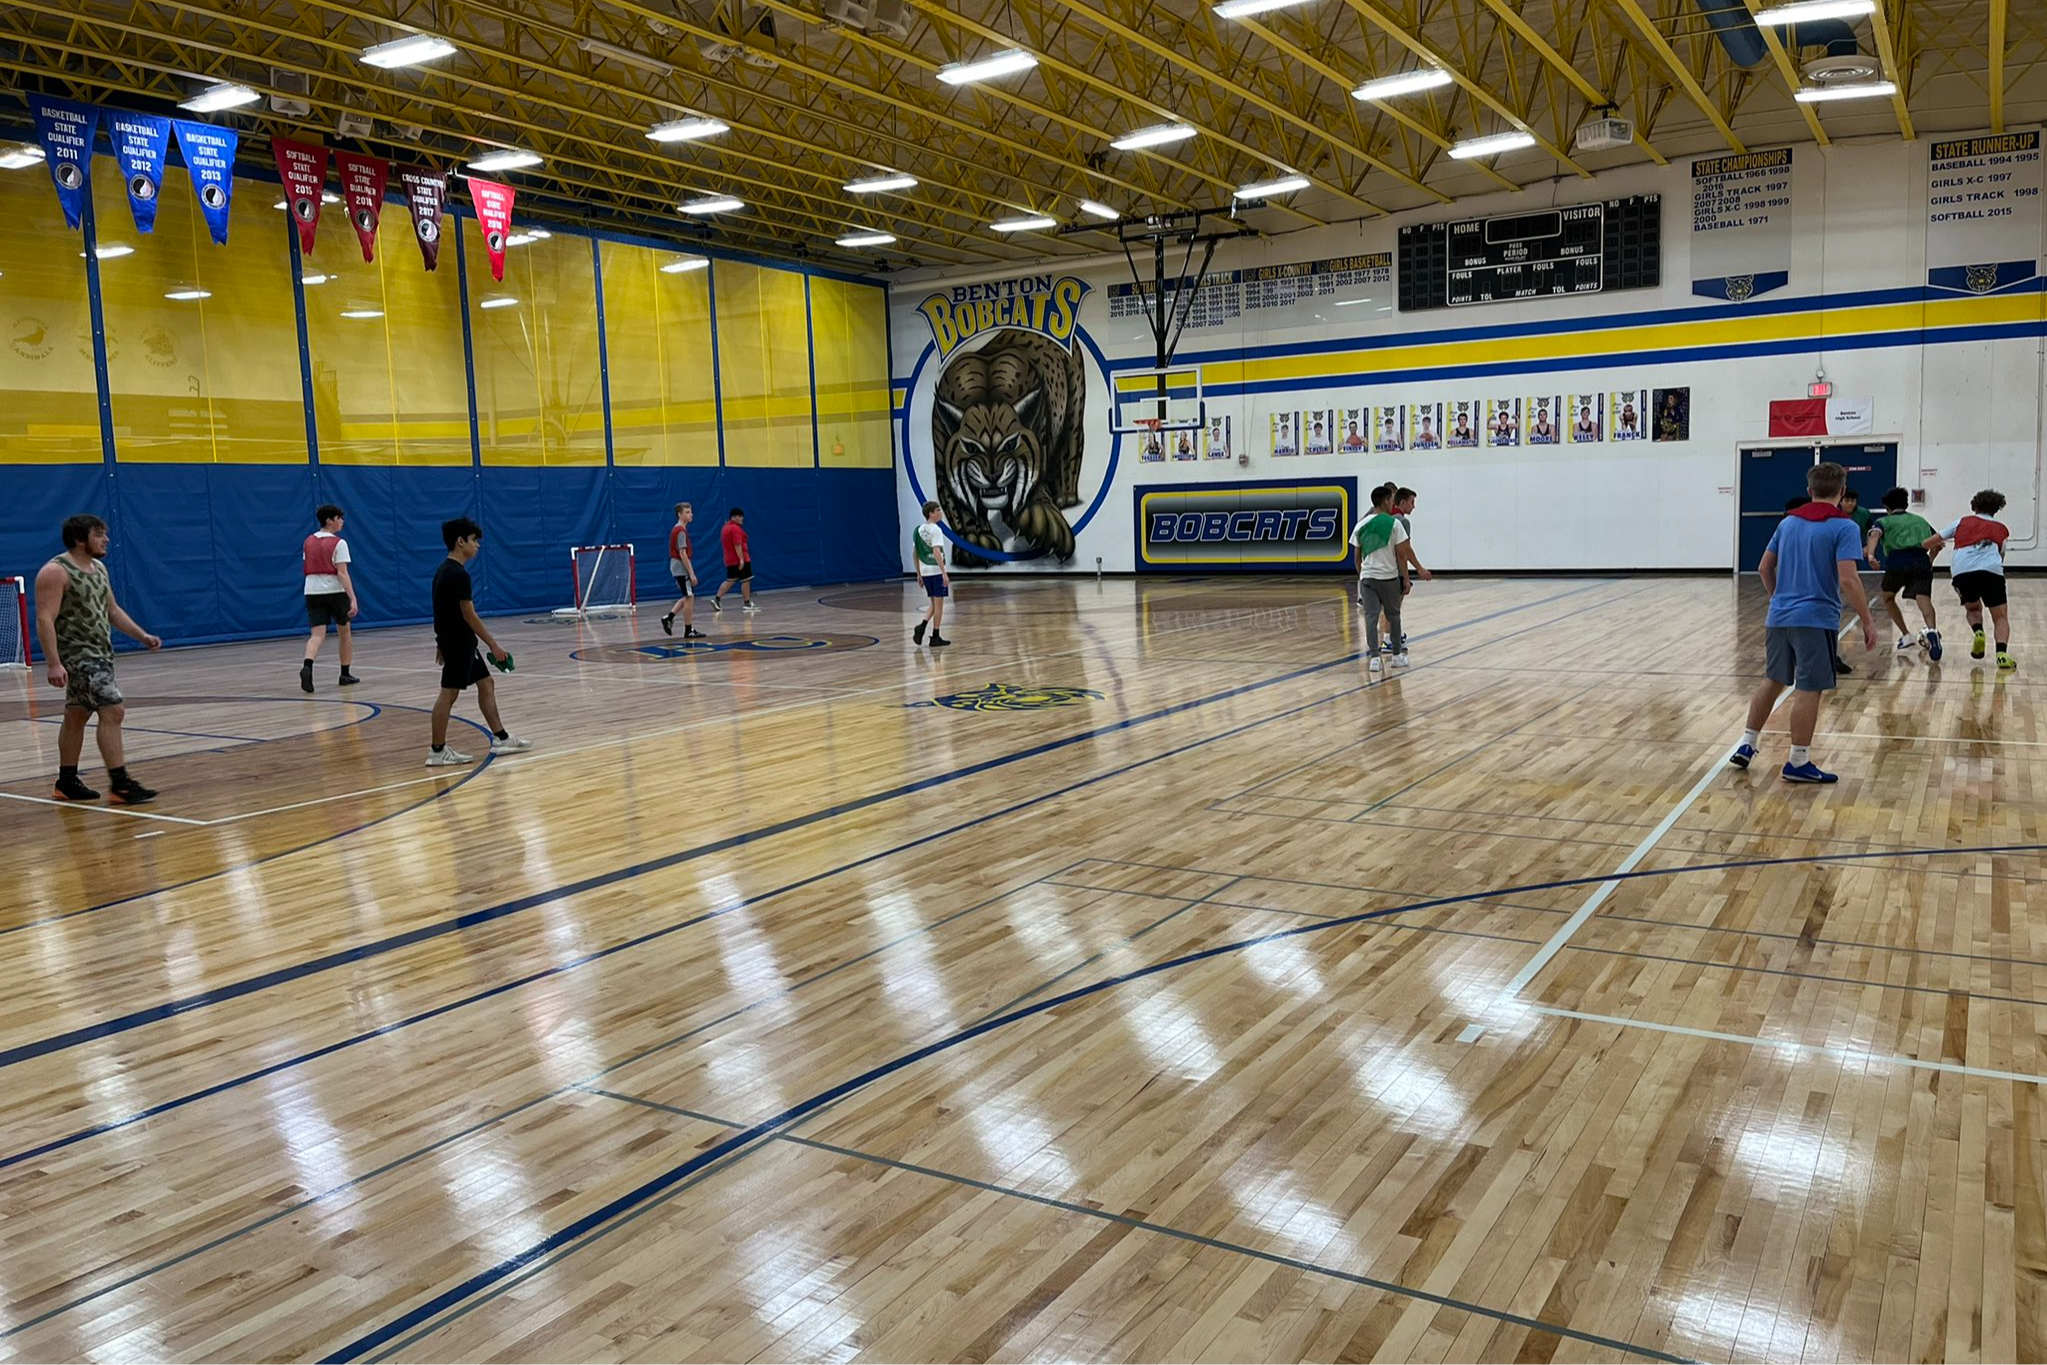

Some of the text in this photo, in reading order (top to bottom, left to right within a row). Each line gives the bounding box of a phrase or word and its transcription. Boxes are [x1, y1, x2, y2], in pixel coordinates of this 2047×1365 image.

[42, 107, 87, 124] BASKETBALL
[55, 122, 76, 135] STATE
[116, 122, 159, 137] BASKETBALL
[48, 132, 84, 147] QUALIFIER
[129, 136, 149, 147] STATE
[186, 133, 227, 147] BASKETBALL
[123, 146, 156, 159] QUALIFIER
[199, 147, 218, 157] STATE
[1936, 134, 2034, 159] STATE RUNNER-UP
[57, 147, 78, 160] 2011
[286, 150, 316, 164] SOFTBALL
[131, 160, 152, 172] 2012
[193, 157, 226, 168] QUALIFIER
[293, 162, 310, 173] STATE
[1696, 150, 1788, 176] STATE CHAMPIONSHIPS
[1932, 153, 2039, 171] BASEBALL 1994 1995
[201, 170, 221, 181] 2013
[348, 163, 376, 176] SOFTBALL
[1695, 166, 1790, 186] SOFTBALL 1966 1998
[288, 172, 318, 184] QUALIFIER
[355, 175, 371, 185] STATE
[402, 174, 420, 184] CROSS
[1932, 173, 2012, 188] GIRLS X-C 1997
[295, 185, 312, 195] 2015
[350, 184, 376, 196] QUALIFIER
[417, 187, 432, 196] STATE
[1695, 182, 1788, 201] GIRLS TRACK 1997
[1703, 183, 1724, 192] 2016
[413, 195, 438, 206] QUALIFIER
[1609, 200, 1619, 208] NO
[1644, 195, 1658, 203] PTS
[1694, 196, 1741, 209] 2007 2008
[1931, 188, 2038, 205] GIRLS TRACK 1998
[486, 200, 501, 209] STATE
[1694, 198, 1790, 216] GIRLS X-C 1998 1999
[419, 207, 434, 217] 2017
[1563, 207, 1600, 221] VISITOR
[1931, 207, 2012, 222] SOFTBALL 2015
[1693, 215, 1716, 224] 2000
[1694, 216, 1768, 232] BASEBALL 1971
[1403, 227, 1411, 235] NO
[1433, 223, 1444, 231] PTS
[1454, 223, 1480, 235] HOME
[1504, 248, 1528, 258] PERIOD
[1561, 246, 1584, 255] BONUS
[1330, 253, 1391, 272] GIRLS BASKETBALL
[1465, 257, 1486, 266] BONUS
[1576, 258, 1598, 266] FOULS
[1259, 263, 1312, 280] GIRLS X-COUNTRY
[1497, 262, 1554, 275] PLAYER FOULS
[1212, 272, 1233, 286] TRACK
[1452, 272, 1472, 280] FOULS
[952, 275, 1052, 303] BENTON
[1336, 279, 1353, 287] 2002
[1575, 282, 1598, 291] POINTS
[1319, 288, 1335, 296] 2013
[1515, 289, 1536, 297] MATCH
[921, 279, 1082, 356] BOBCATS
[1150, 509, 1338, 542] BOBCATS
